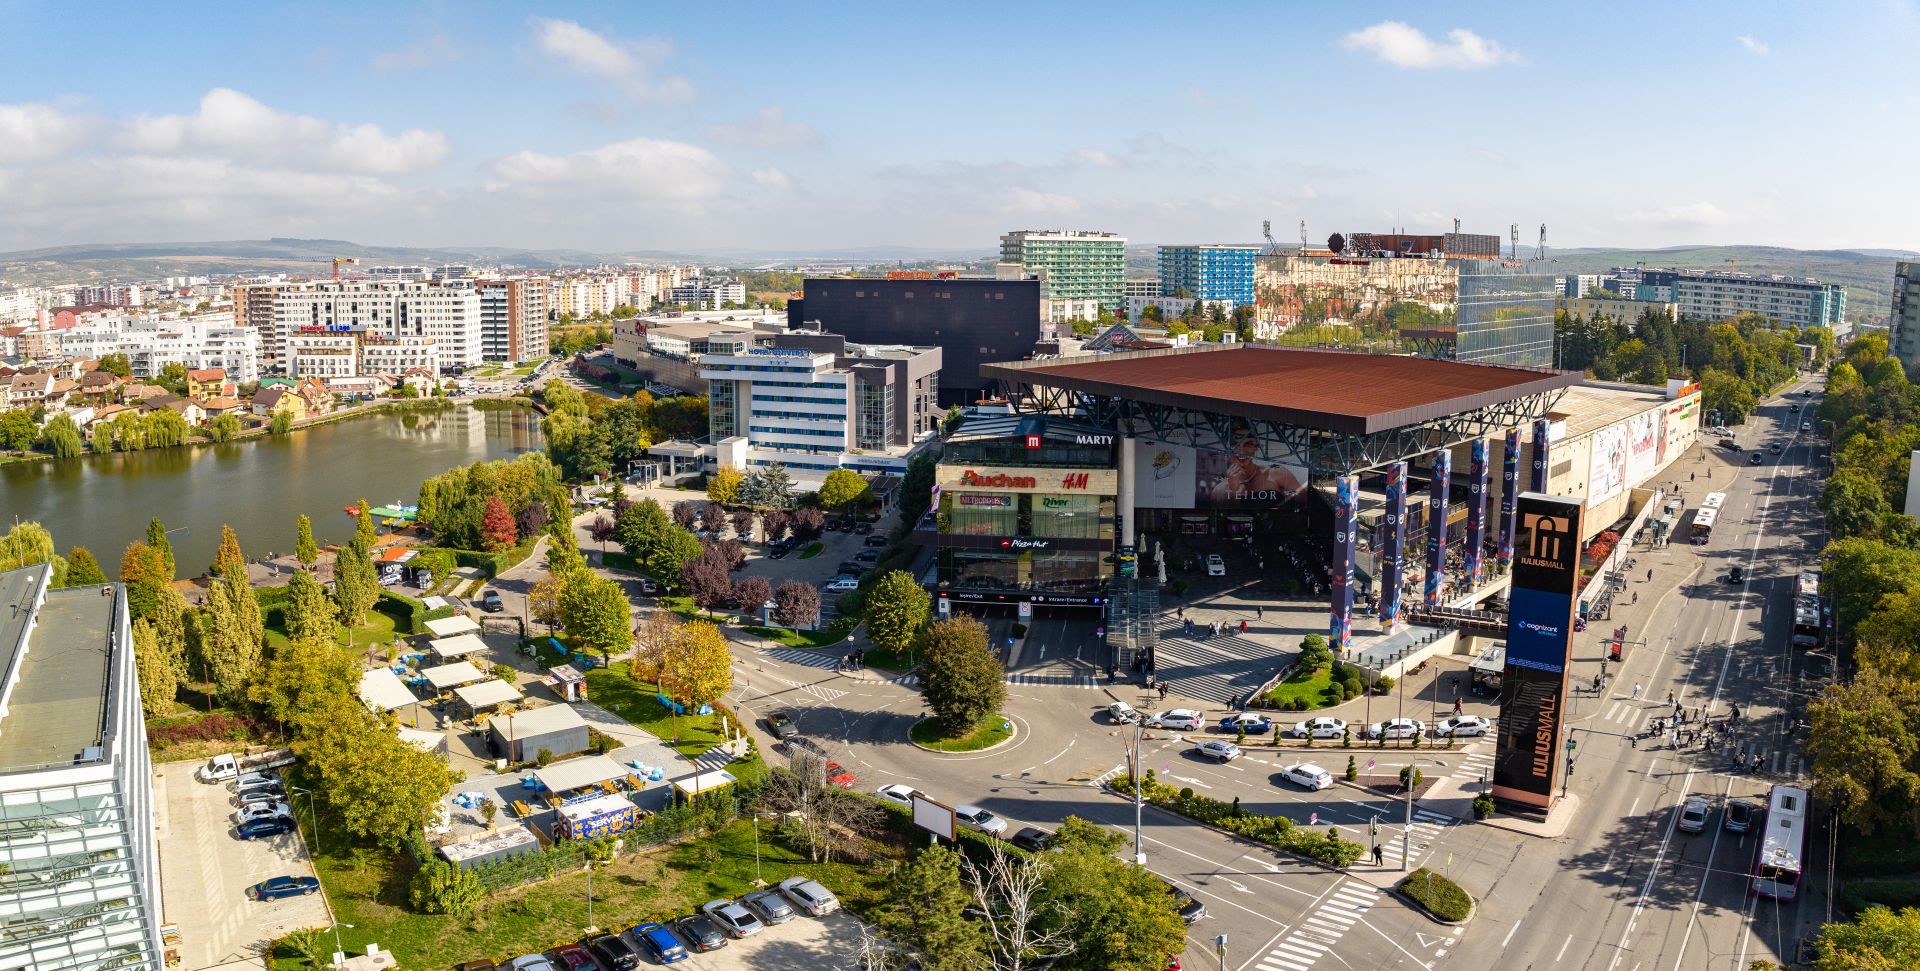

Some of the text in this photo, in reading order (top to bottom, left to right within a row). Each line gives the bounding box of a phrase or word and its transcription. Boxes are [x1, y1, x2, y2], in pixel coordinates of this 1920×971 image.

[1076, 435, 1113, 445] MARTY
[960, 470, 1036, 488] Auchan
[1224, 490, 1278, 500] TEILOR
[1011, 539, 1048, 548] Pizza Hut
[1520, 556, 1565, 570] IULIUSMALL
[1526, 623, 1558, 632] cognizant
[1532, 694, 1556, 778] IULIUSMALL
